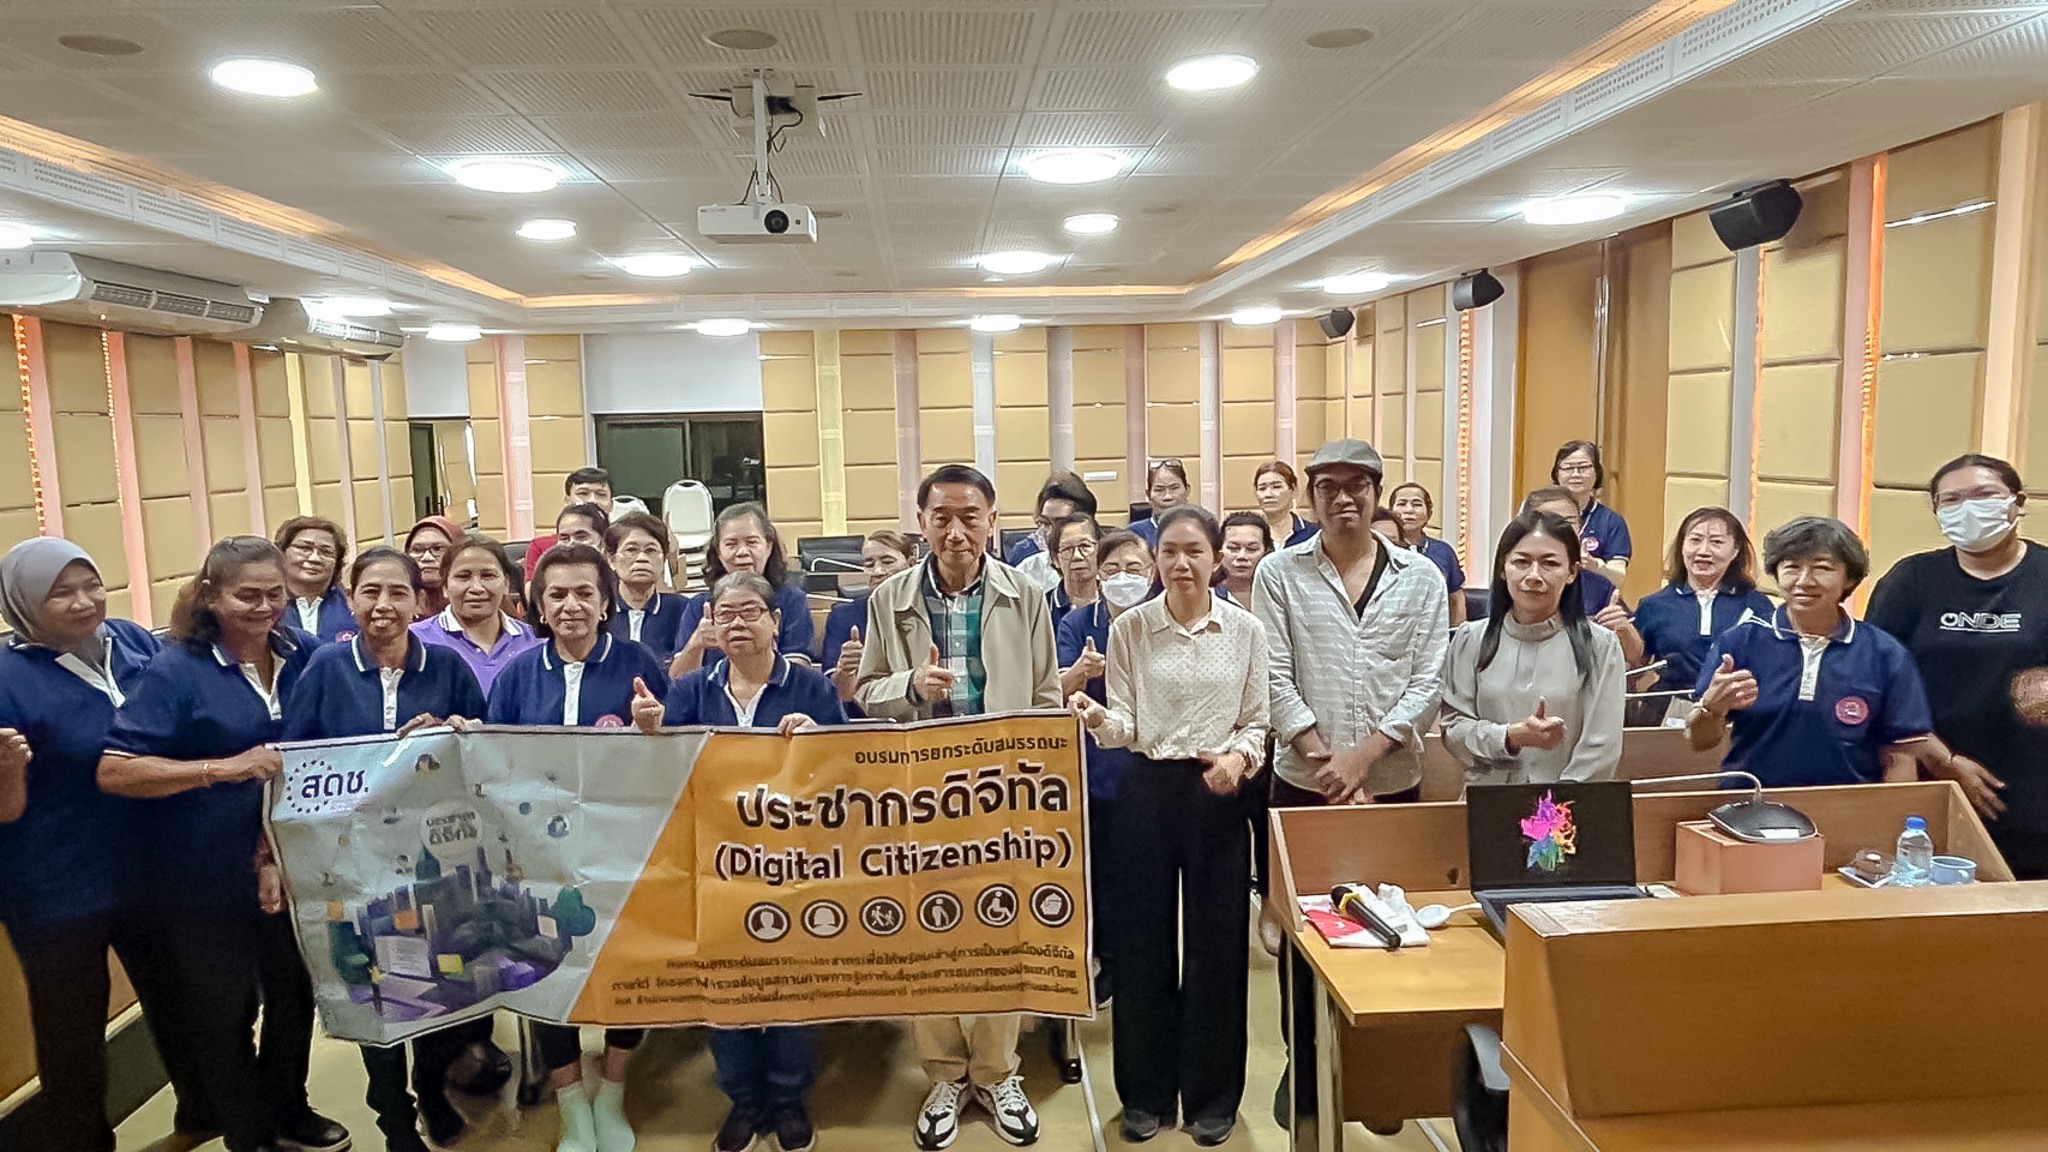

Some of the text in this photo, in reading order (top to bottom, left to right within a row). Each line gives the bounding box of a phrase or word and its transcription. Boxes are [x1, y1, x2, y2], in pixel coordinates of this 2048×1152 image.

[1940, 612, 2022, 629] ONDE
[855, 737, 1068, 764] อบรมการยกระดับสมรรถนะ
[301, 769, 369, 799] สดช.
[736, 759, 1071, 830] ประชากรดิจิทัล
[714, 827, 1074, 887] (Digital Citizenship)
